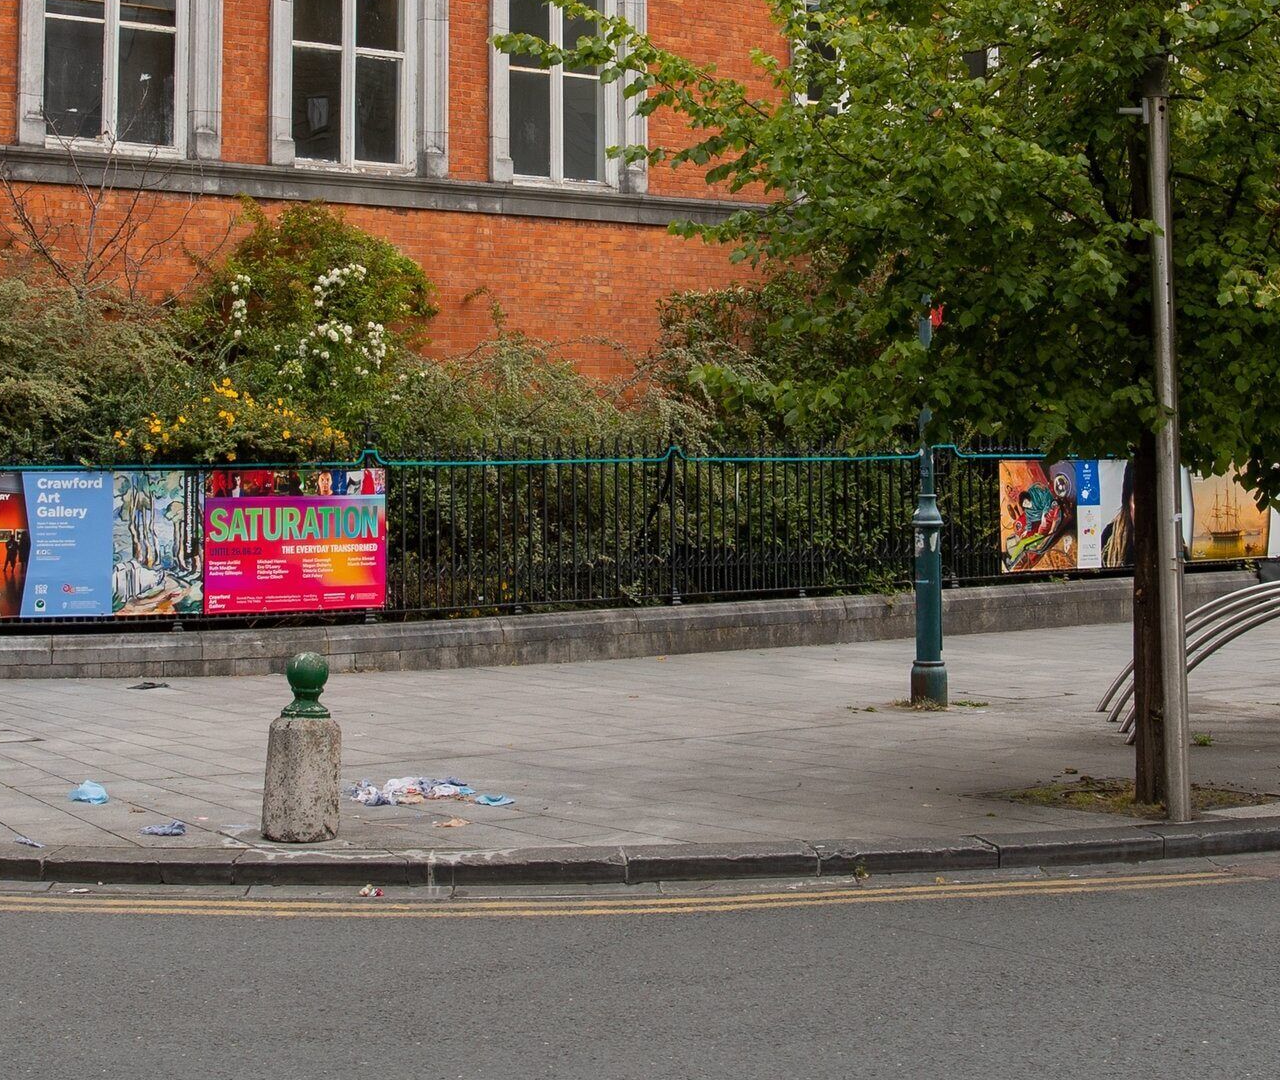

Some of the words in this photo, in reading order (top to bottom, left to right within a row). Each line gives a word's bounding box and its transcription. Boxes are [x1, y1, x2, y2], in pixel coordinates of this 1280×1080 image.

[37, 477, 103, 489] Crawford
[37, 492, 60, 503] Art
[37, 506, 88, 519] Gallery
[209, 505, 379, 543] SATURATION
[210, 547, 229, 556] UNTIL
[282, 545, 295, 554] THE
[296, 544, 329, 554] EVERYDAY
[330, 543, 378, 553] TRANSFORMED
